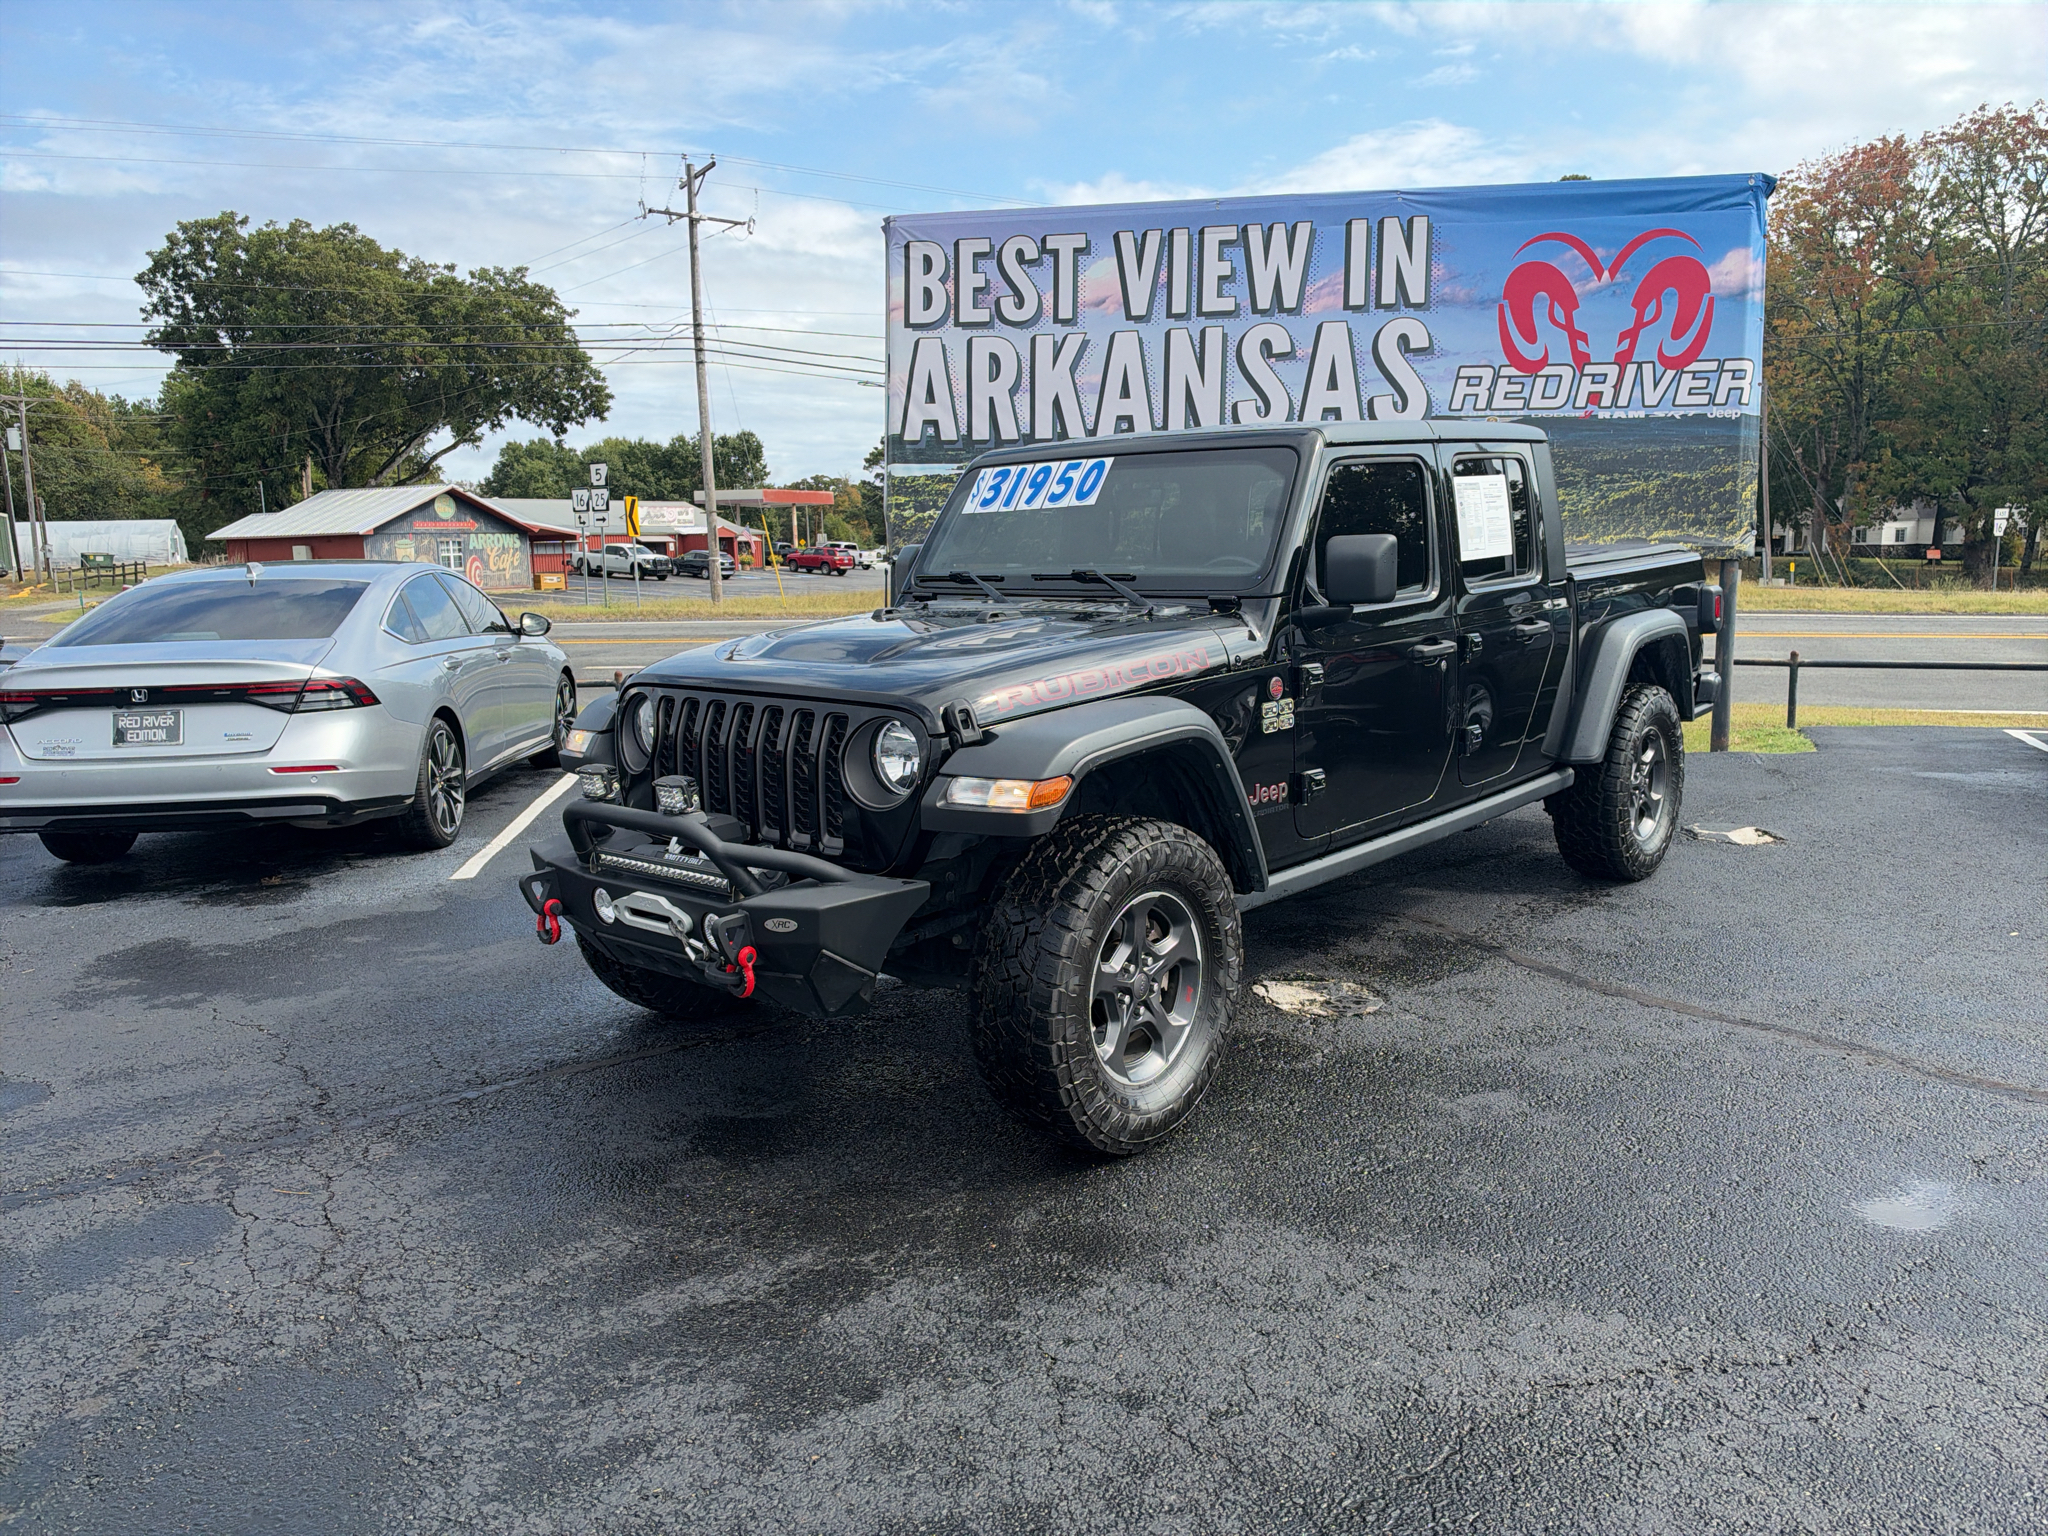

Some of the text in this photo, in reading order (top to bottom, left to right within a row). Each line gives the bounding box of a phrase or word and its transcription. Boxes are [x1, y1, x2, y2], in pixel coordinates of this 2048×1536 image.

[903, 215, 1430, 328] BEST VIEW IN
[902, 316, 1432, 442] ARKANSAS
[1598, 410, 1645, 419] RAM
[1707, 406, 1741, 420] Jeep
[595, 468, 603, 482] 5
[970, 459, 1107, 509] $31950
[575, 494, 586, 508] 16
[594, 493, 606, 508] 25
[1995, 522, 2003, 533] 16
[469, 533, 521, 550] ARROWS
[993, 648, 1210, 711] RUBICON
[118, 714, 175, 729] RED RIVER
[126, 728, 167, 742] EDITION
[1249, 782, 1289, 806] Jeep
